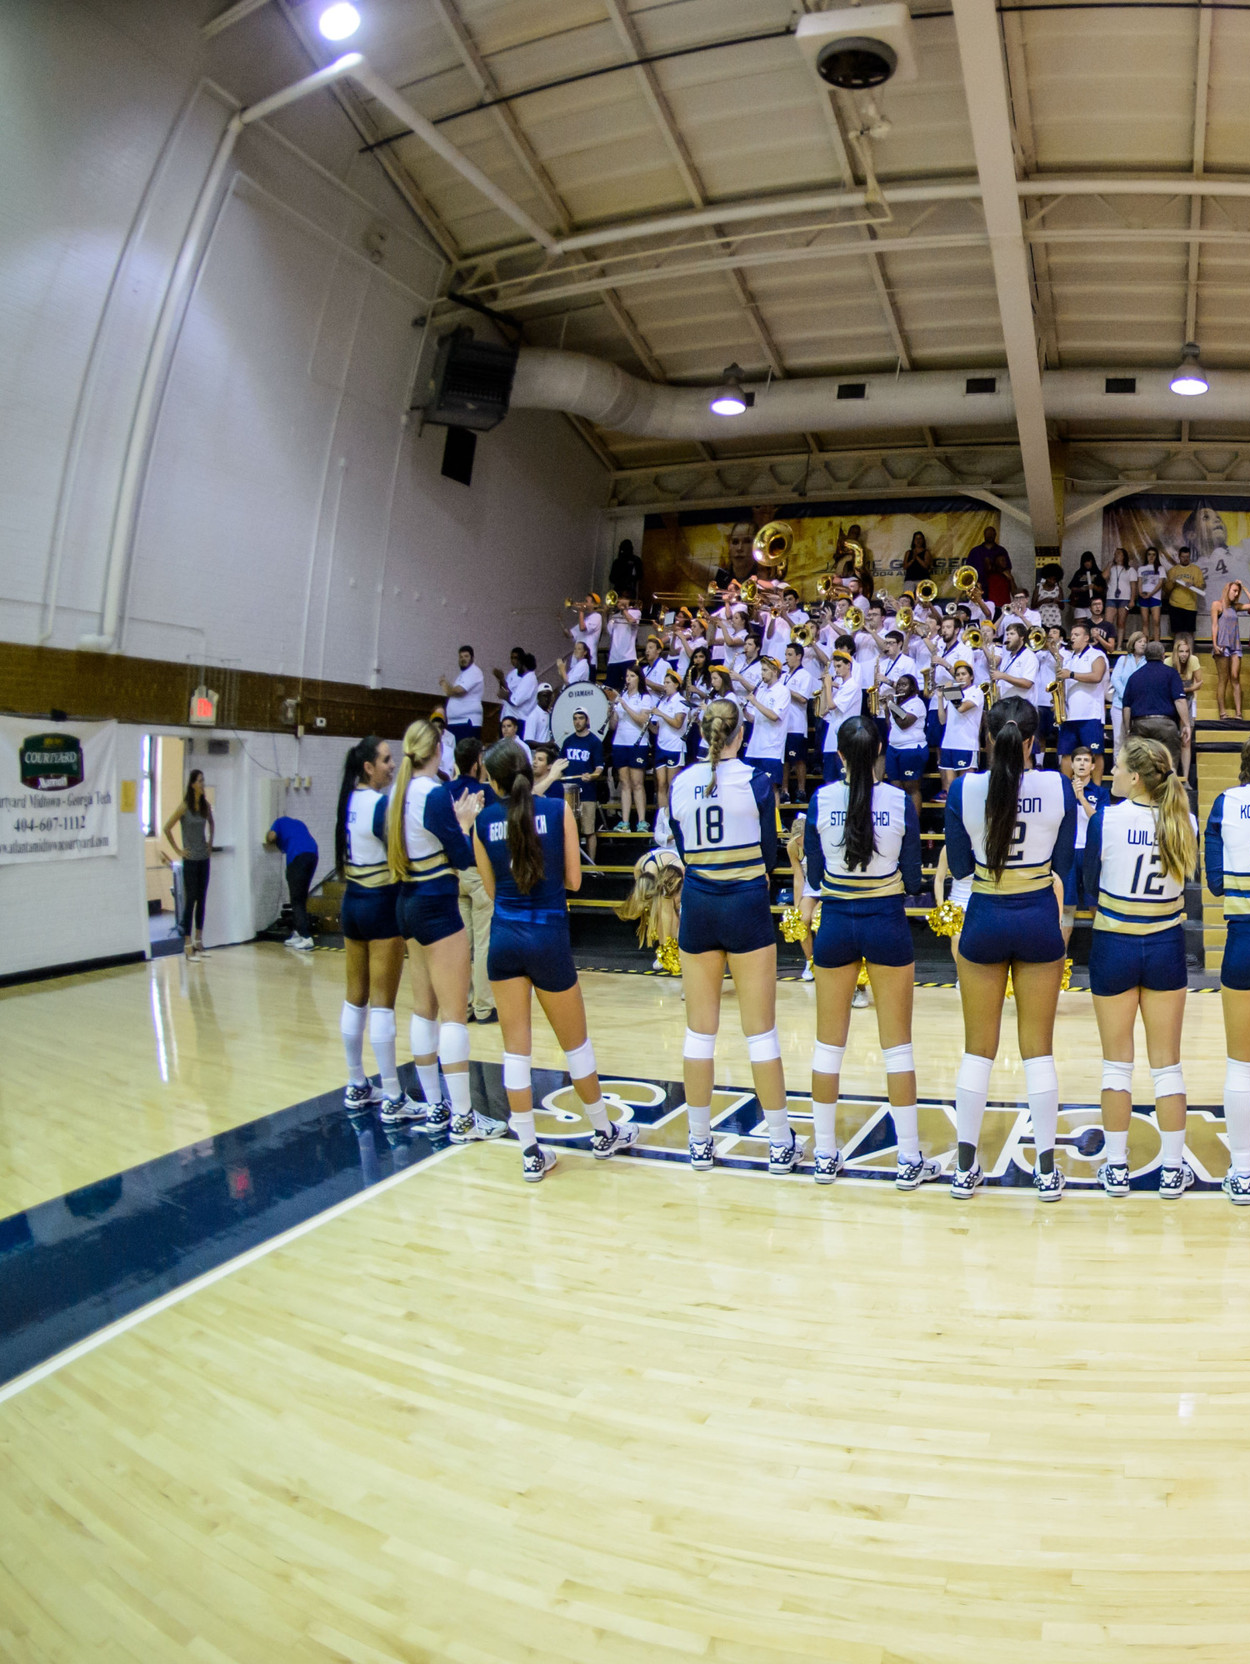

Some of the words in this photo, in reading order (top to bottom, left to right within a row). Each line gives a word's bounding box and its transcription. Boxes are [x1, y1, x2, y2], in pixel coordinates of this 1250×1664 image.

[574, 689, 594, 698] YAMAHA
[25, 751, 77, 764] COURTYARD
[67, 793, 93, 808] Georgia
[96, 790, 112, 804] Tech
[14, 815, 86, 832] 404-607-1112
[695, 804, 724, 846] 18
[1130, 853, 1167, 895] 12
